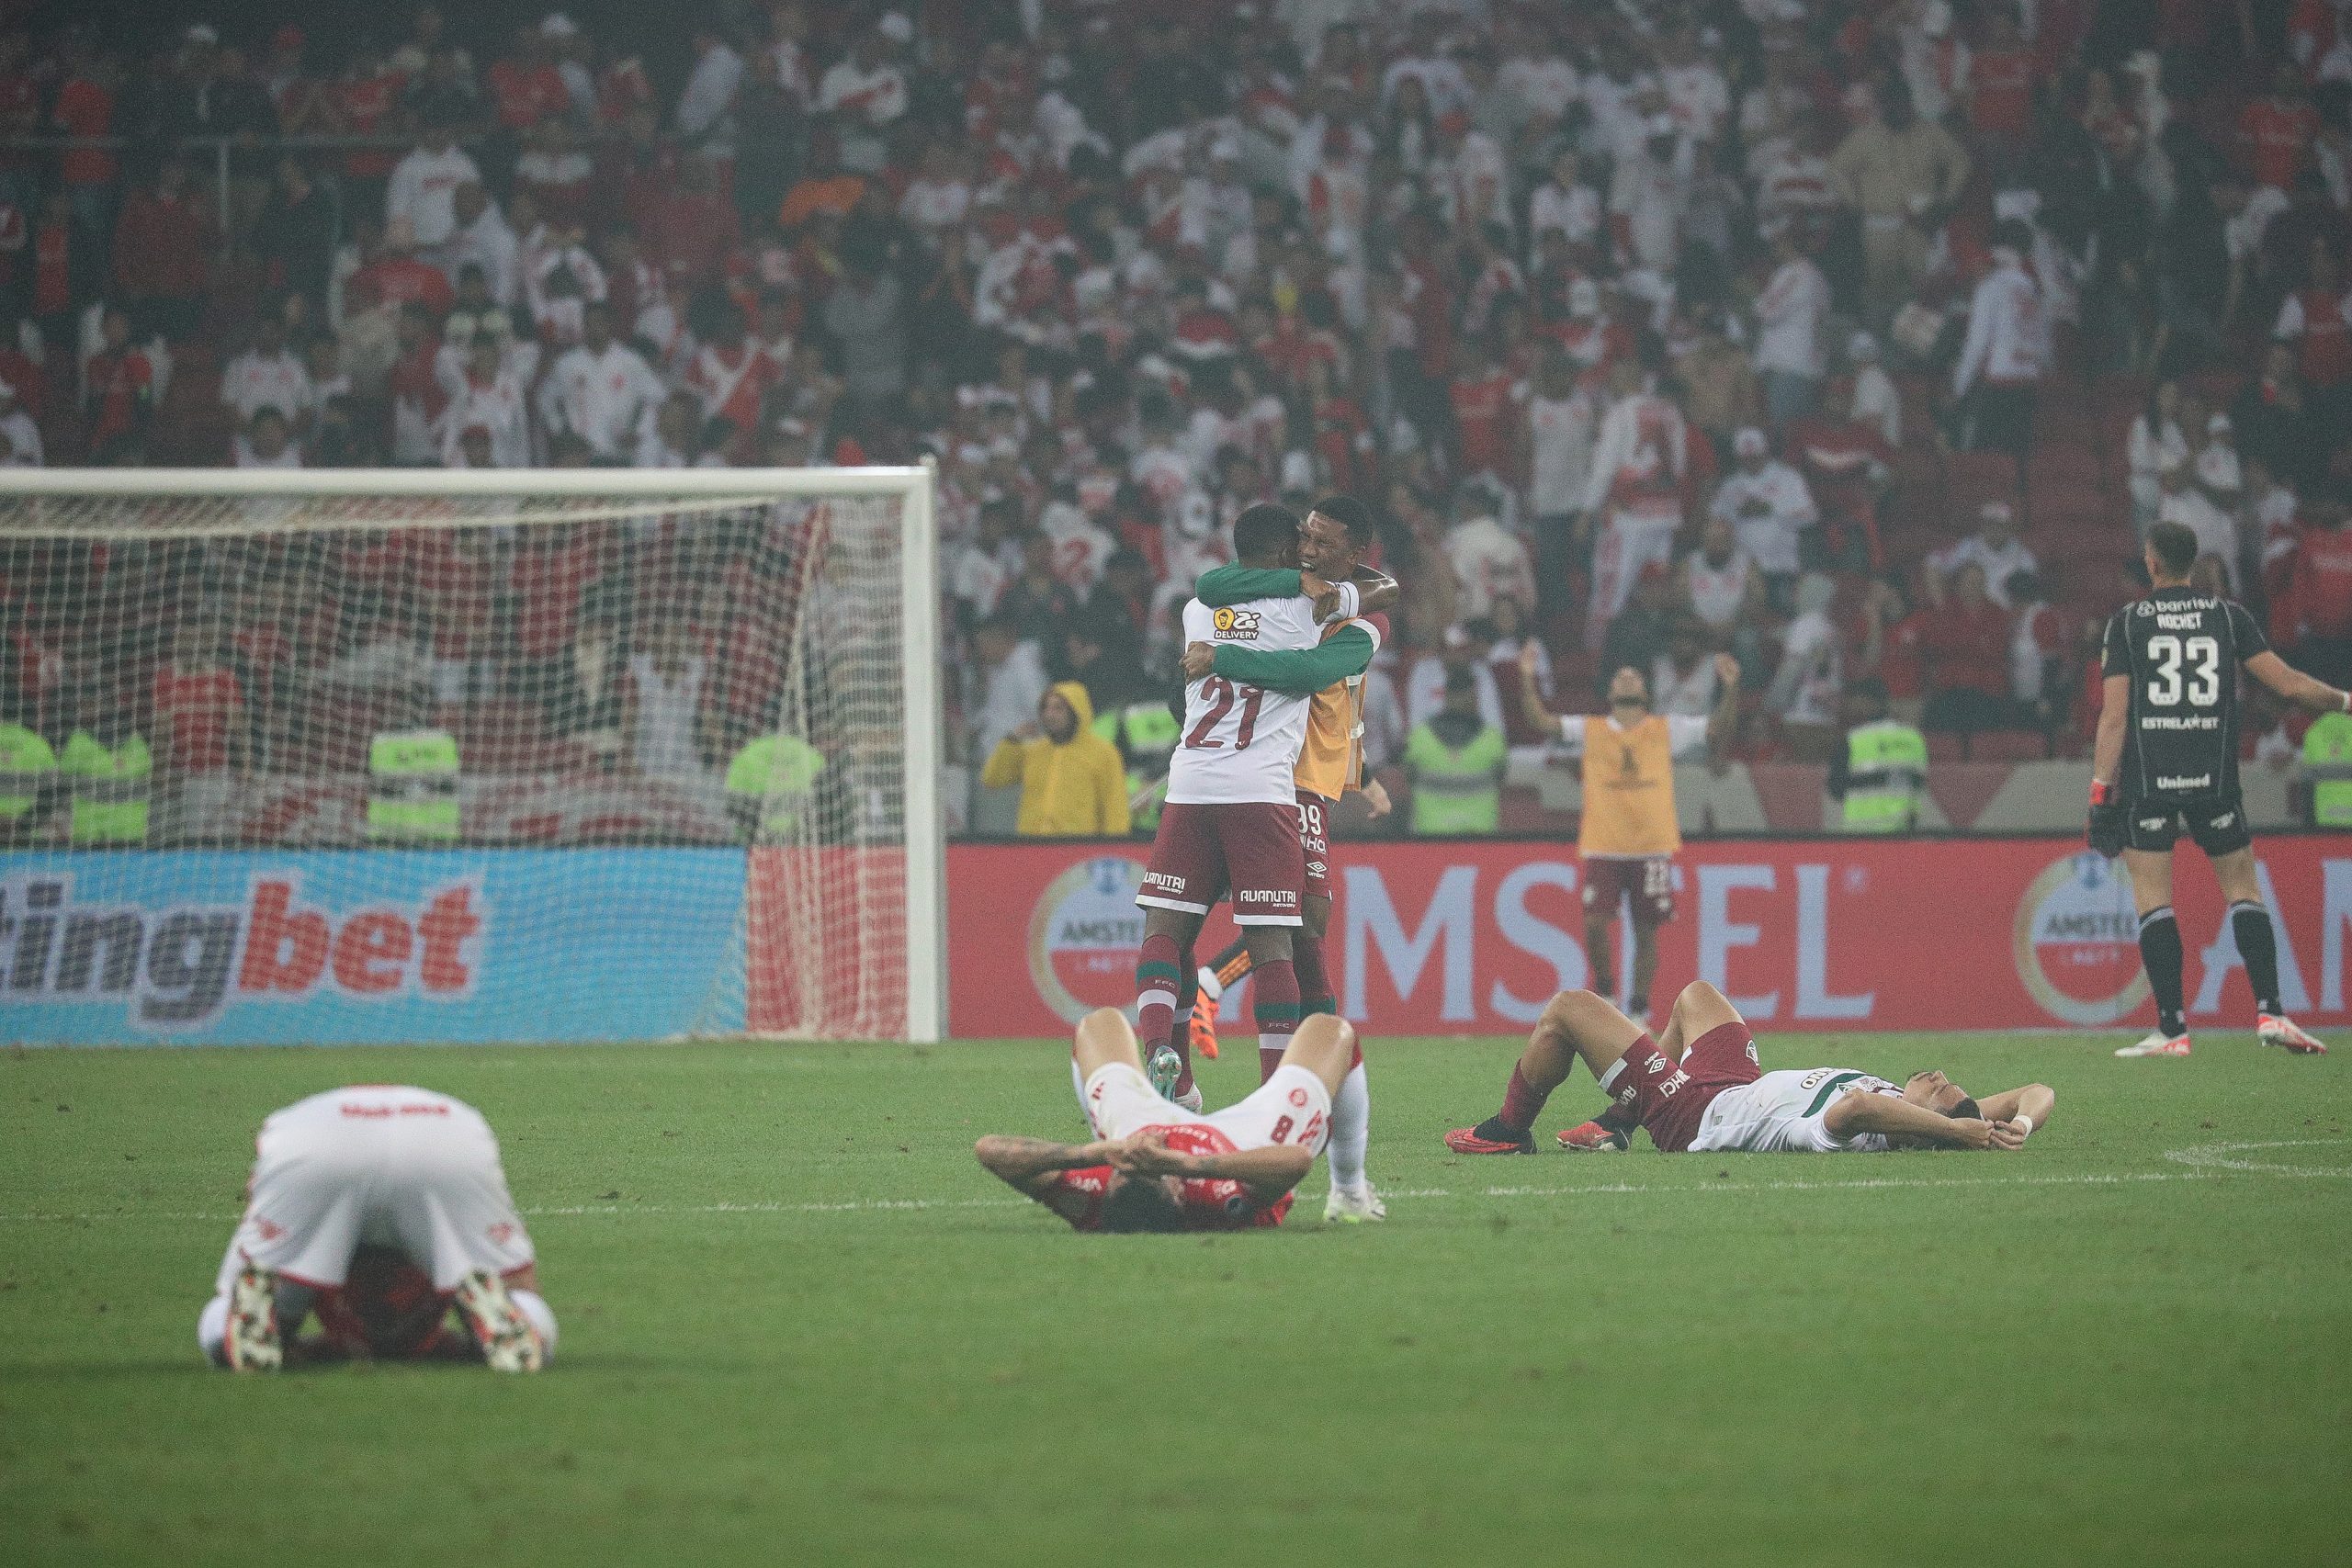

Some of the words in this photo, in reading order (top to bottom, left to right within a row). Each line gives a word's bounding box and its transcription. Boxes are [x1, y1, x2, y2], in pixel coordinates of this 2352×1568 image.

[1215, 630, 1258, 639] DELIVERY
[2148, 636, 2219, 706] 33
[1185, 676, 1265, 751] 21
[2156, 773, 2211, 790] Unimed
[0, 881, 481, 1022] ingbet
[1059, 919, 1146, 942] AMSTE
[1215, 860, 1874, 1023] MSEL
[1154, 978, 1176, 989] FFC
